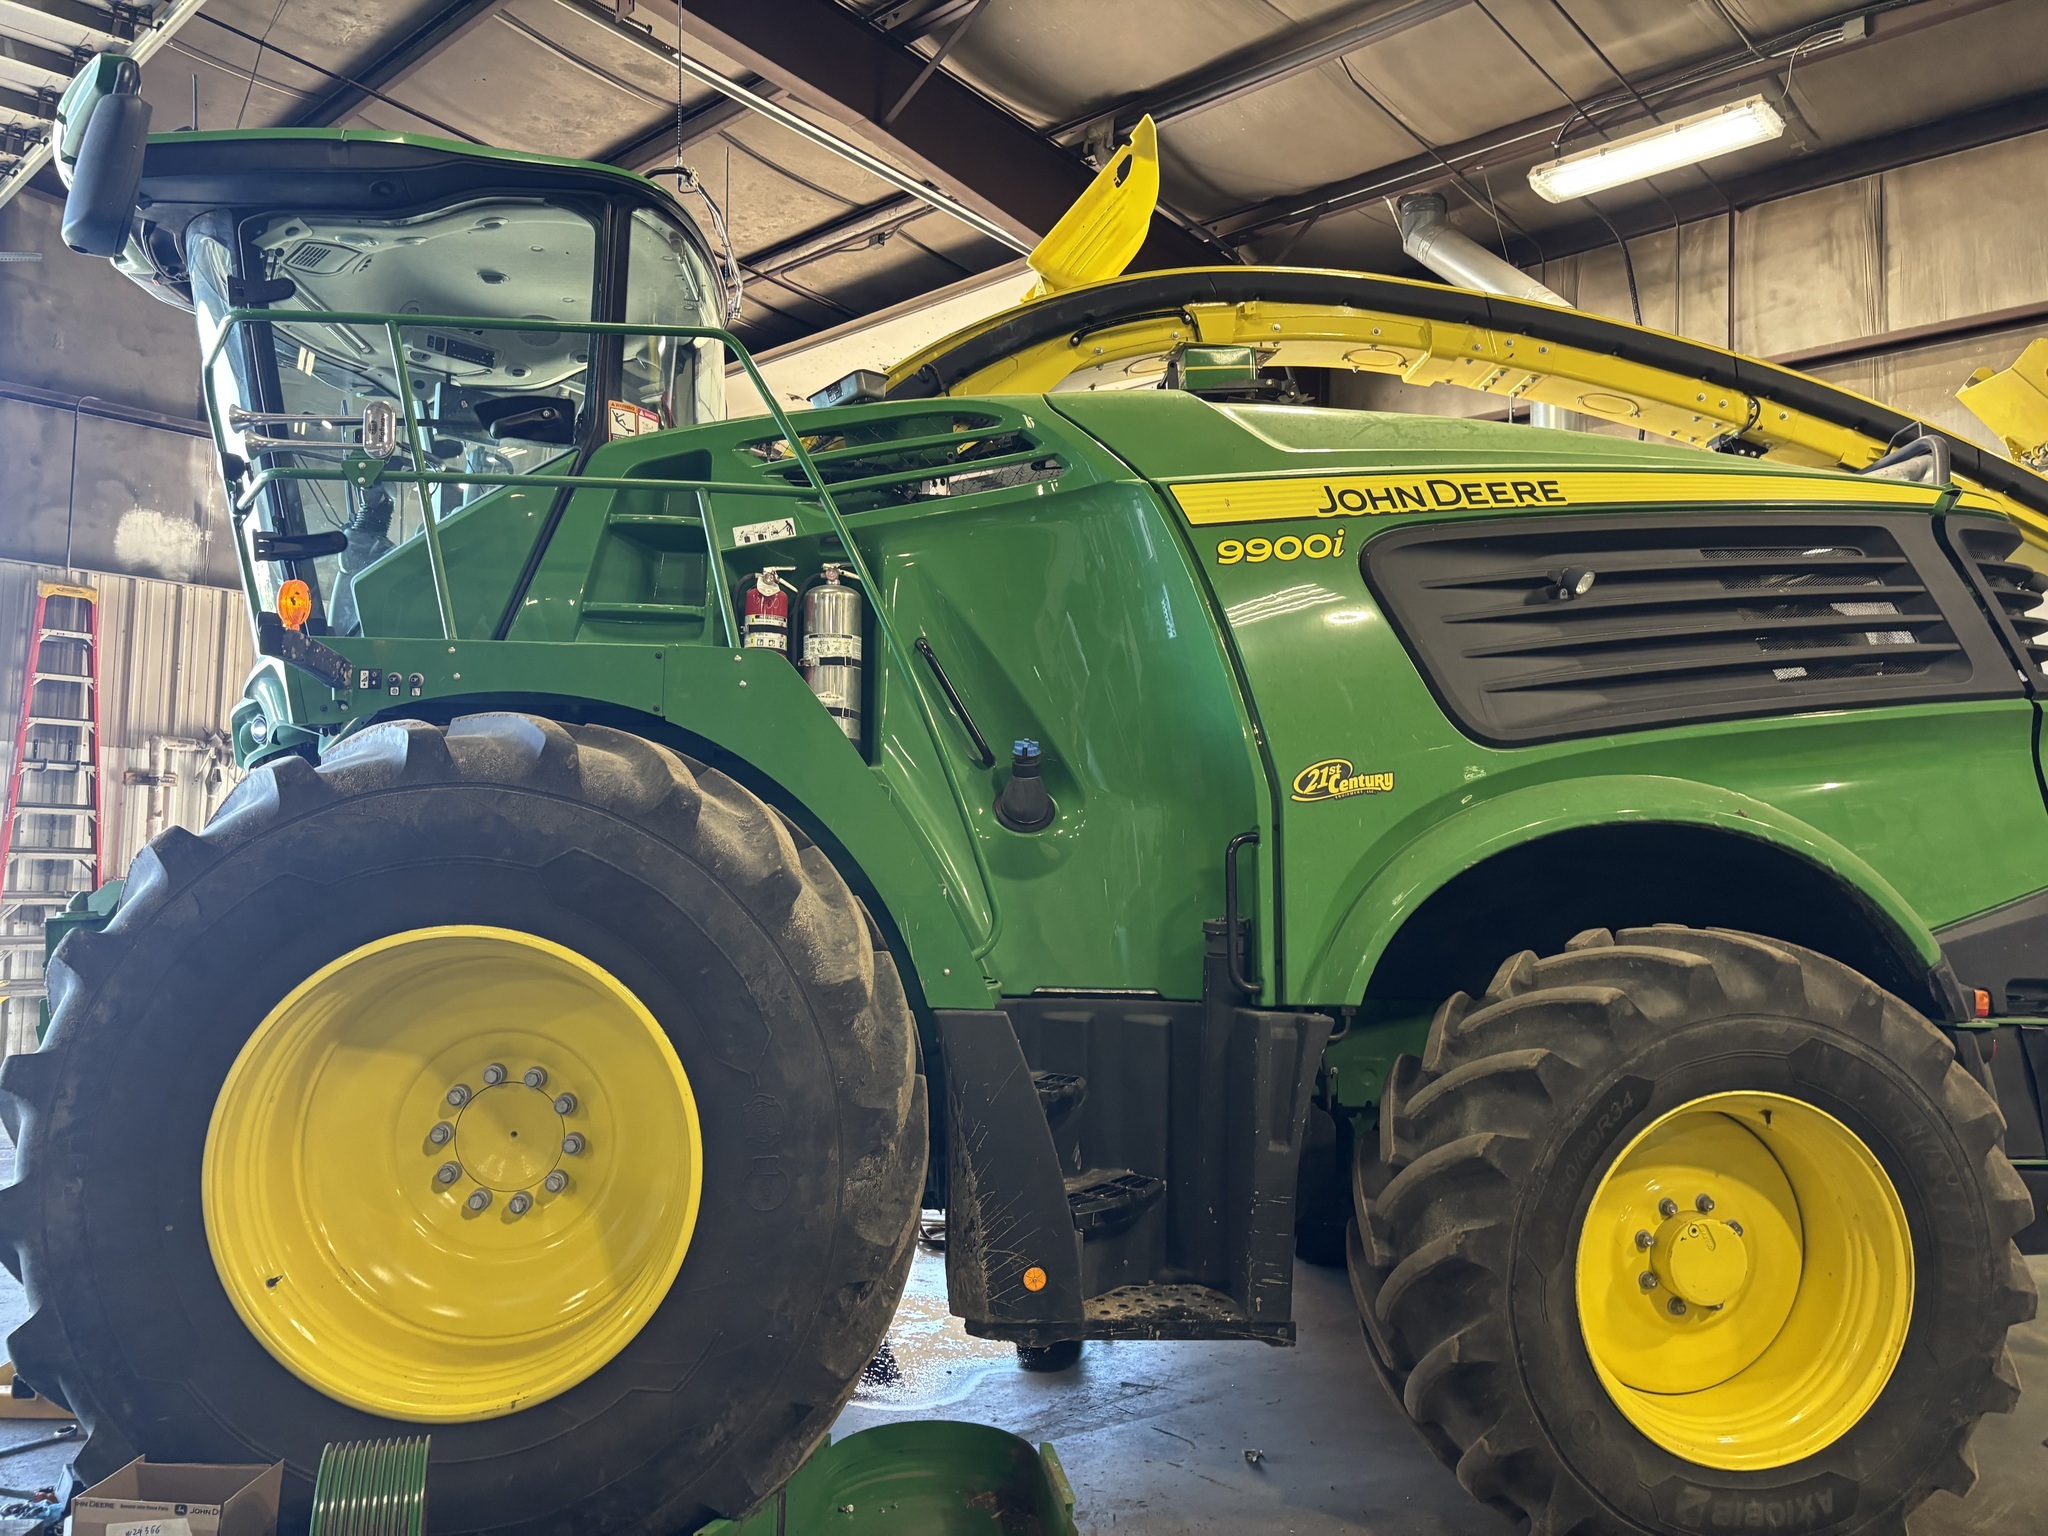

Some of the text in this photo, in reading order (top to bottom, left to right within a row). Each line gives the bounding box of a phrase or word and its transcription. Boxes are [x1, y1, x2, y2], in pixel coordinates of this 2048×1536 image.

[1318, 480, 1566, 514] JOHN DEERE
[1216, 529, 1345, 565] 9900i
[1303, 763, 1342, 794] 21st
[189, 1507, 211, 1515] JOHN
